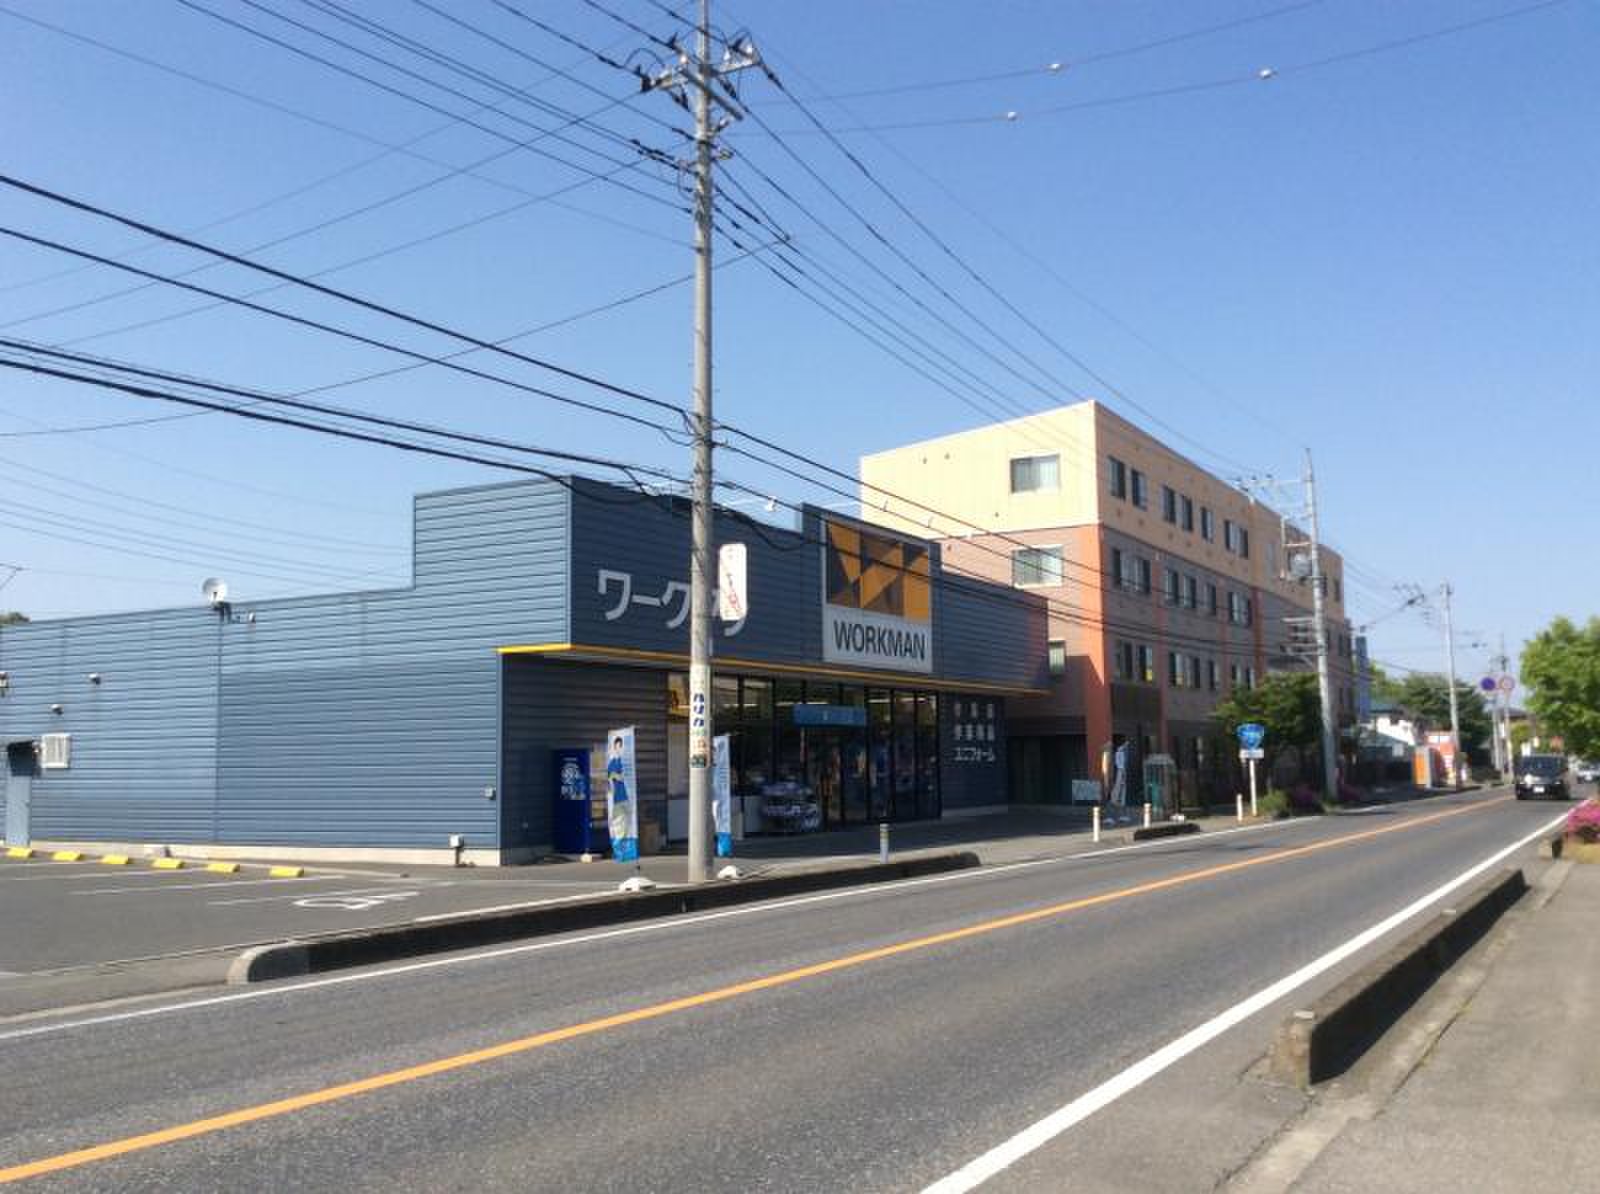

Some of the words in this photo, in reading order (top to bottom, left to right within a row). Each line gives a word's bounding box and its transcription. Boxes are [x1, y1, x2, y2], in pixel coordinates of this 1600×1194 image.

[597, 569, 747, 636] ワーク
[833, 619, 926, 660] WORKMAN
